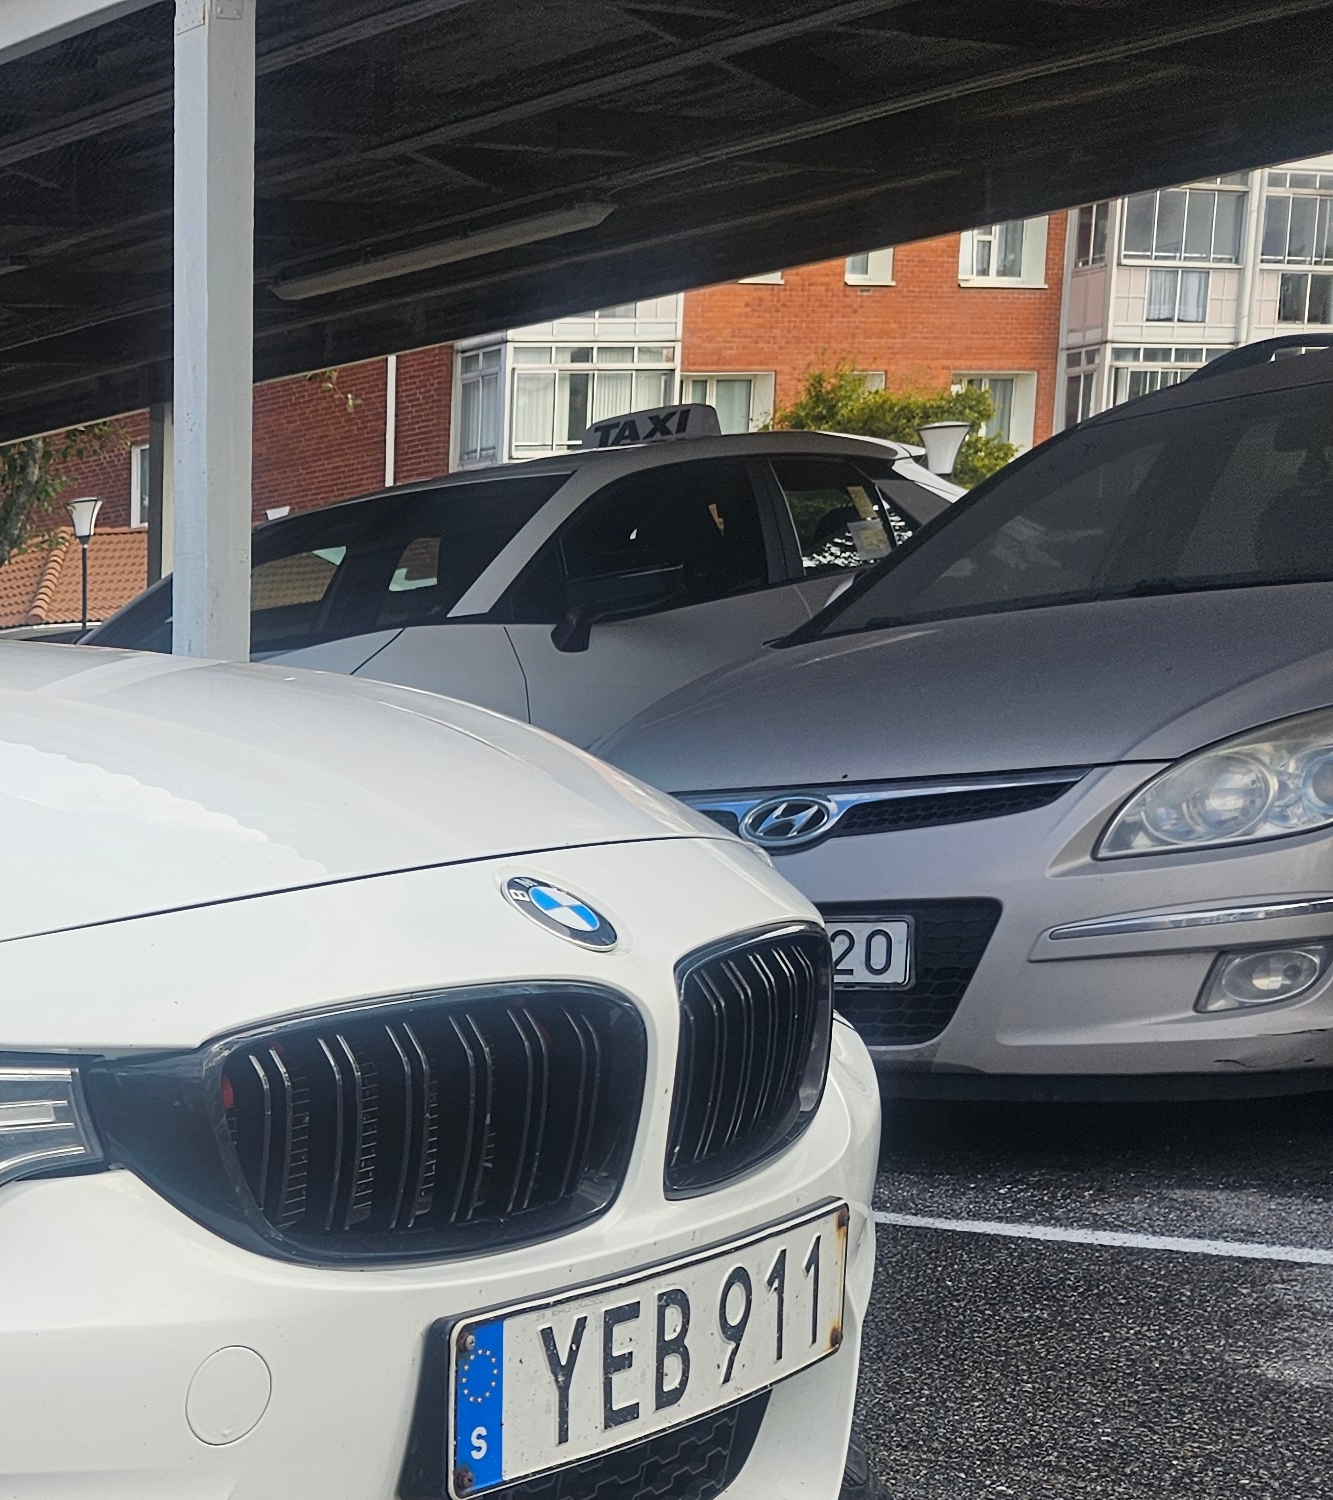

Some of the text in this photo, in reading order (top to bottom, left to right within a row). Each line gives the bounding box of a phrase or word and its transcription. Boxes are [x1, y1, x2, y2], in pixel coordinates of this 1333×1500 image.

[594, 409, 691, 447] TAXI
[539, 1233, 823, 1446] YEB 911
[470, 1426, 488, 1461] S
